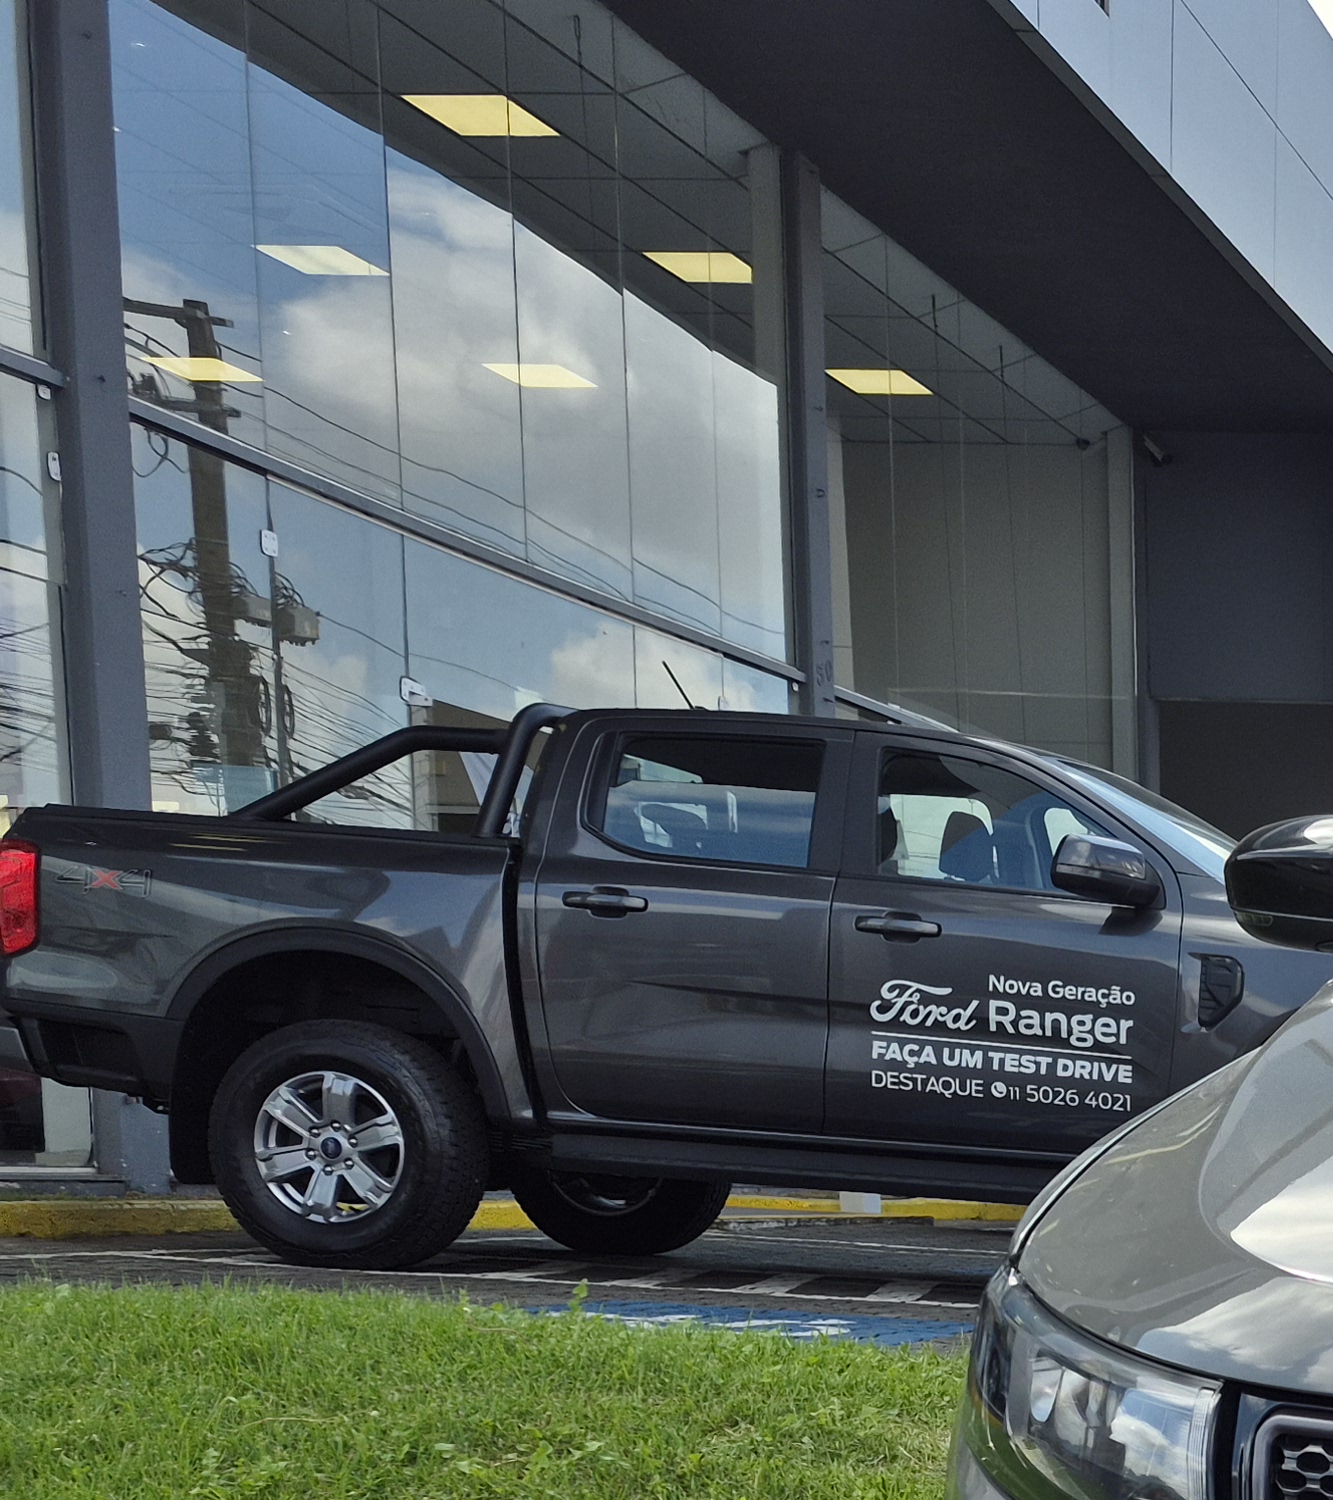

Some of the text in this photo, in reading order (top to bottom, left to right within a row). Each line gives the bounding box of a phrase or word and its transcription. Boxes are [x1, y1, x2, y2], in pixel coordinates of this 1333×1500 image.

[988, 974, 1136, 1008] Nova Geração
[869, 979, 1134, 1048] Ford Ranger
[871, 1040, 1133, 1084] FAÇA UM TEST DRIVE
[870, 1070, 1132, 1113] DESTAQUE 11 5026 4021
